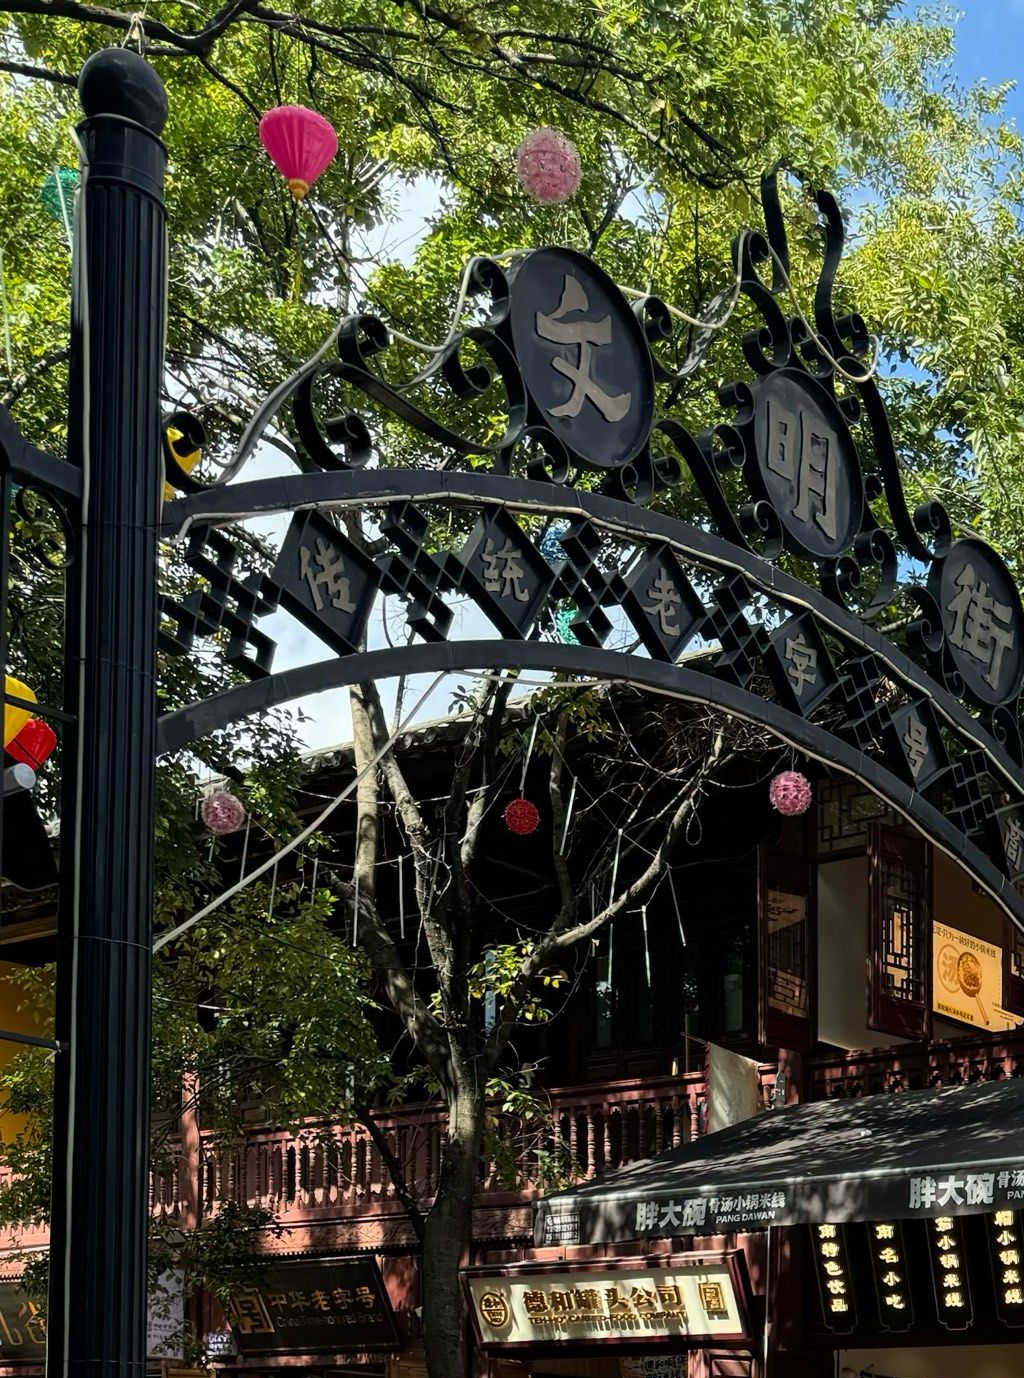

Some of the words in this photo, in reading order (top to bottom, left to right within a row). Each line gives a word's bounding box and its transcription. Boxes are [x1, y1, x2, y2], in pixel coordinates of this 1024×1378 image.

[708, 1192, 787, 1215] 骨汤小锅米线
[909, 1173, 994, 1209] 胖大碗
[635, 1200, 707, 1232] 胖大碗
[715, 1214, 741, 1226] PANG
[742, 1210, 776, 1223] DAWAN
[268, 1287, 377, 1313] 中华老字号
